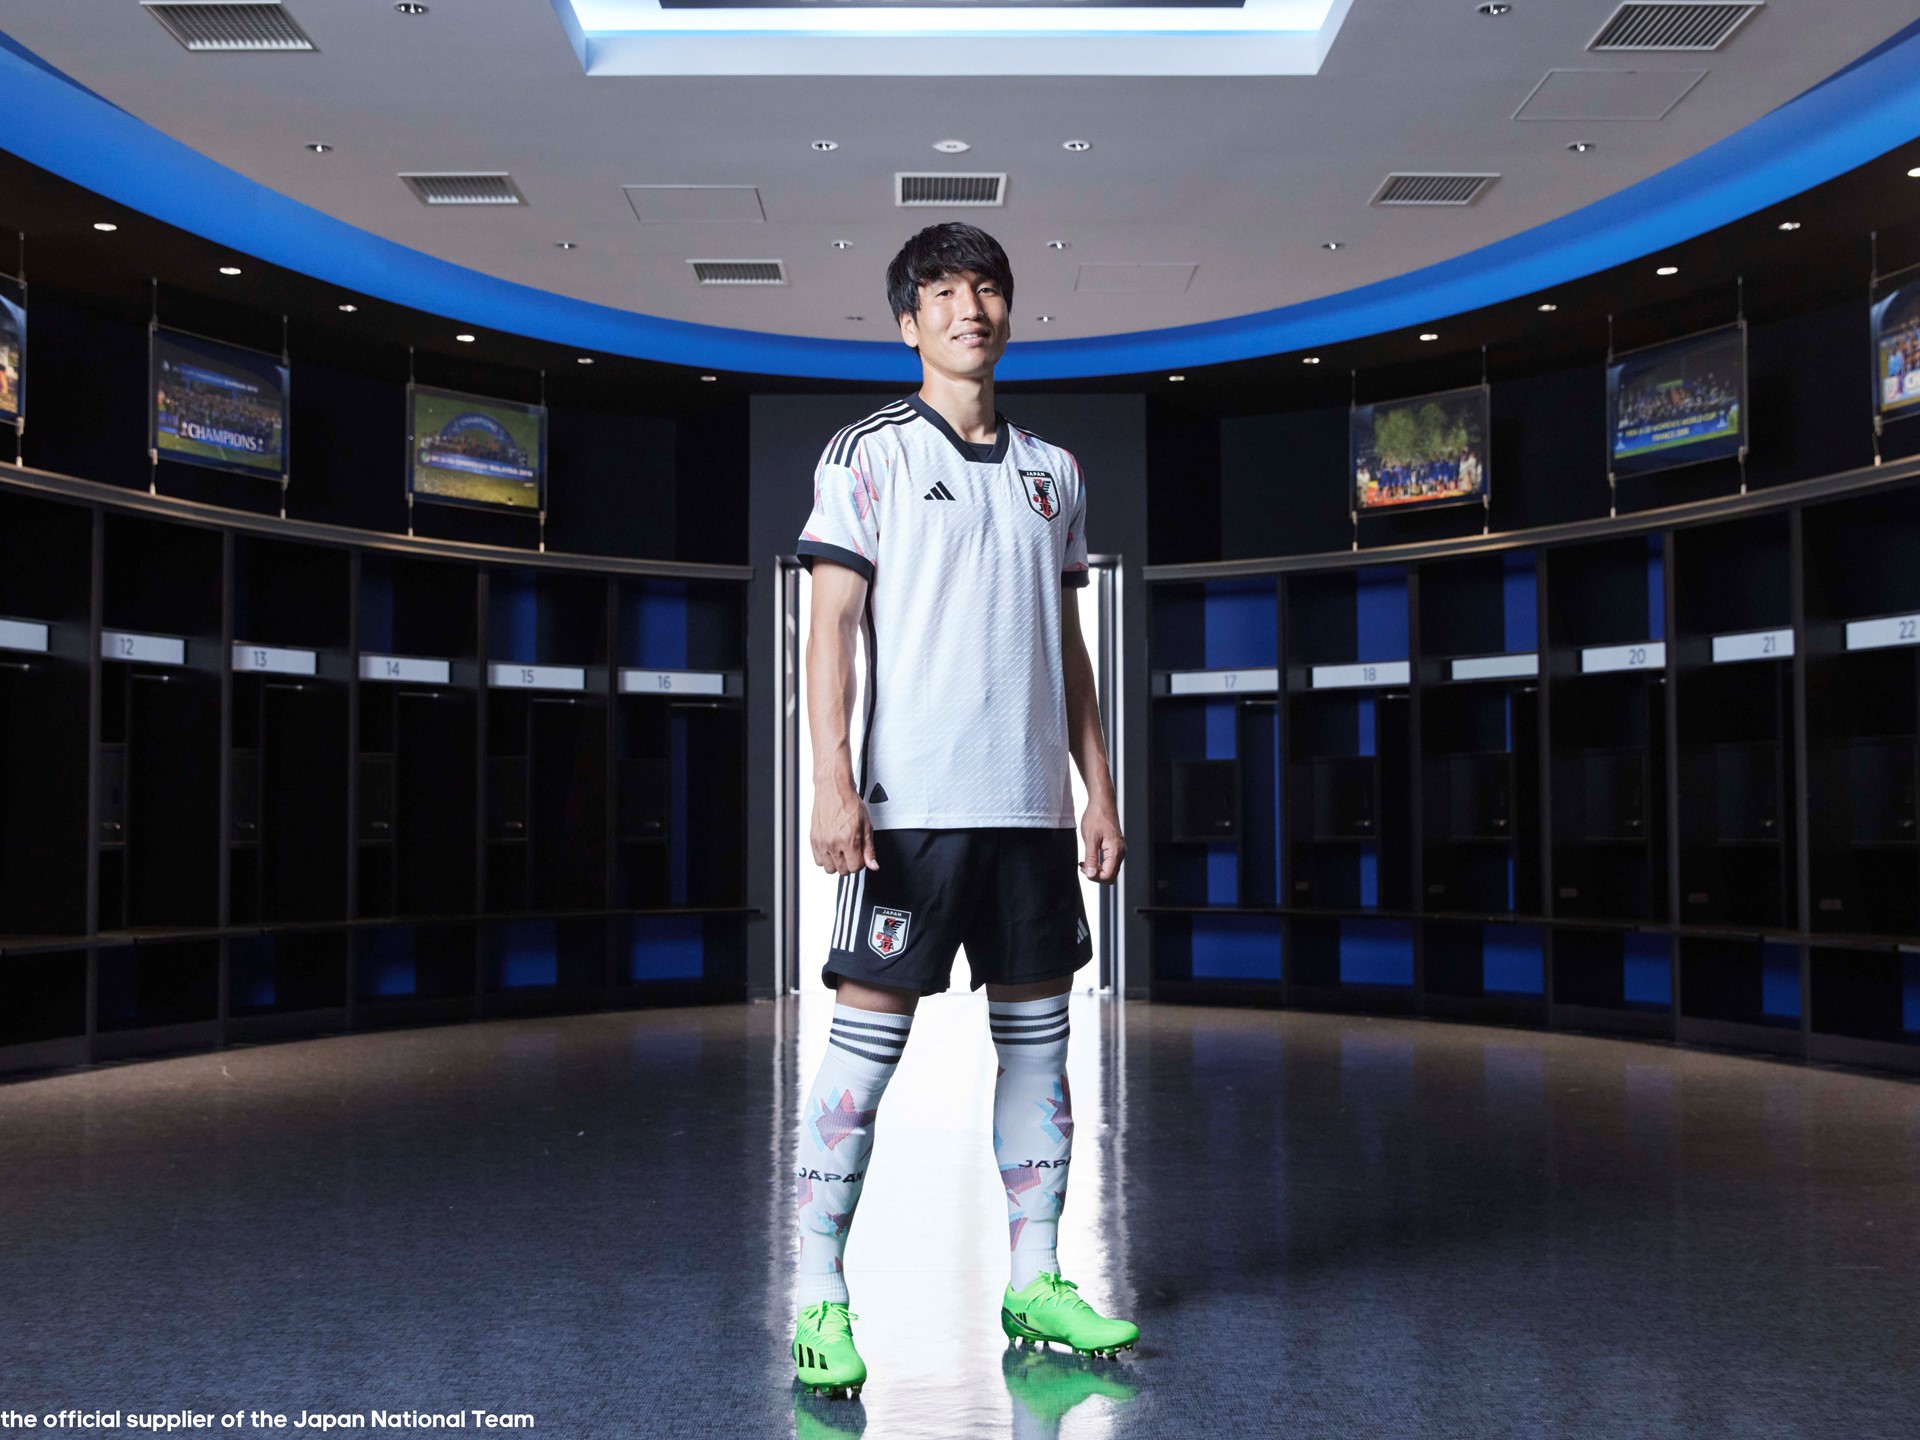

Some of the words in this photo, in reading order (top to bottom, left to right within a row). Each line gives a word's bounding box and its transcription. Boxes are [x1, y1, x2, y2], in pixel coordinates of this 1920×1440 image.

[187, 422, 256, 451] CHAMPIONS
[1898, 620, 1917, 640] 22
[120, 638, 134, 655] 12
[1762, 636, 1776, 653] 21
[253, 651, 267, 667] 13
[1628, 648, 1647, 665] 20
[386, 660, 400, 676] 14
[1362, 667, 1377, 682] 18
[521, 669, 535, 684] 15
[658, 675, 672, 690] 16
[1224, 674, 1238, 689] 17
[882, 909, 902, 917] JAPAN
[877, 940, 895, 951] JFA
[799, 1167, 864, 1183] JAPAN
